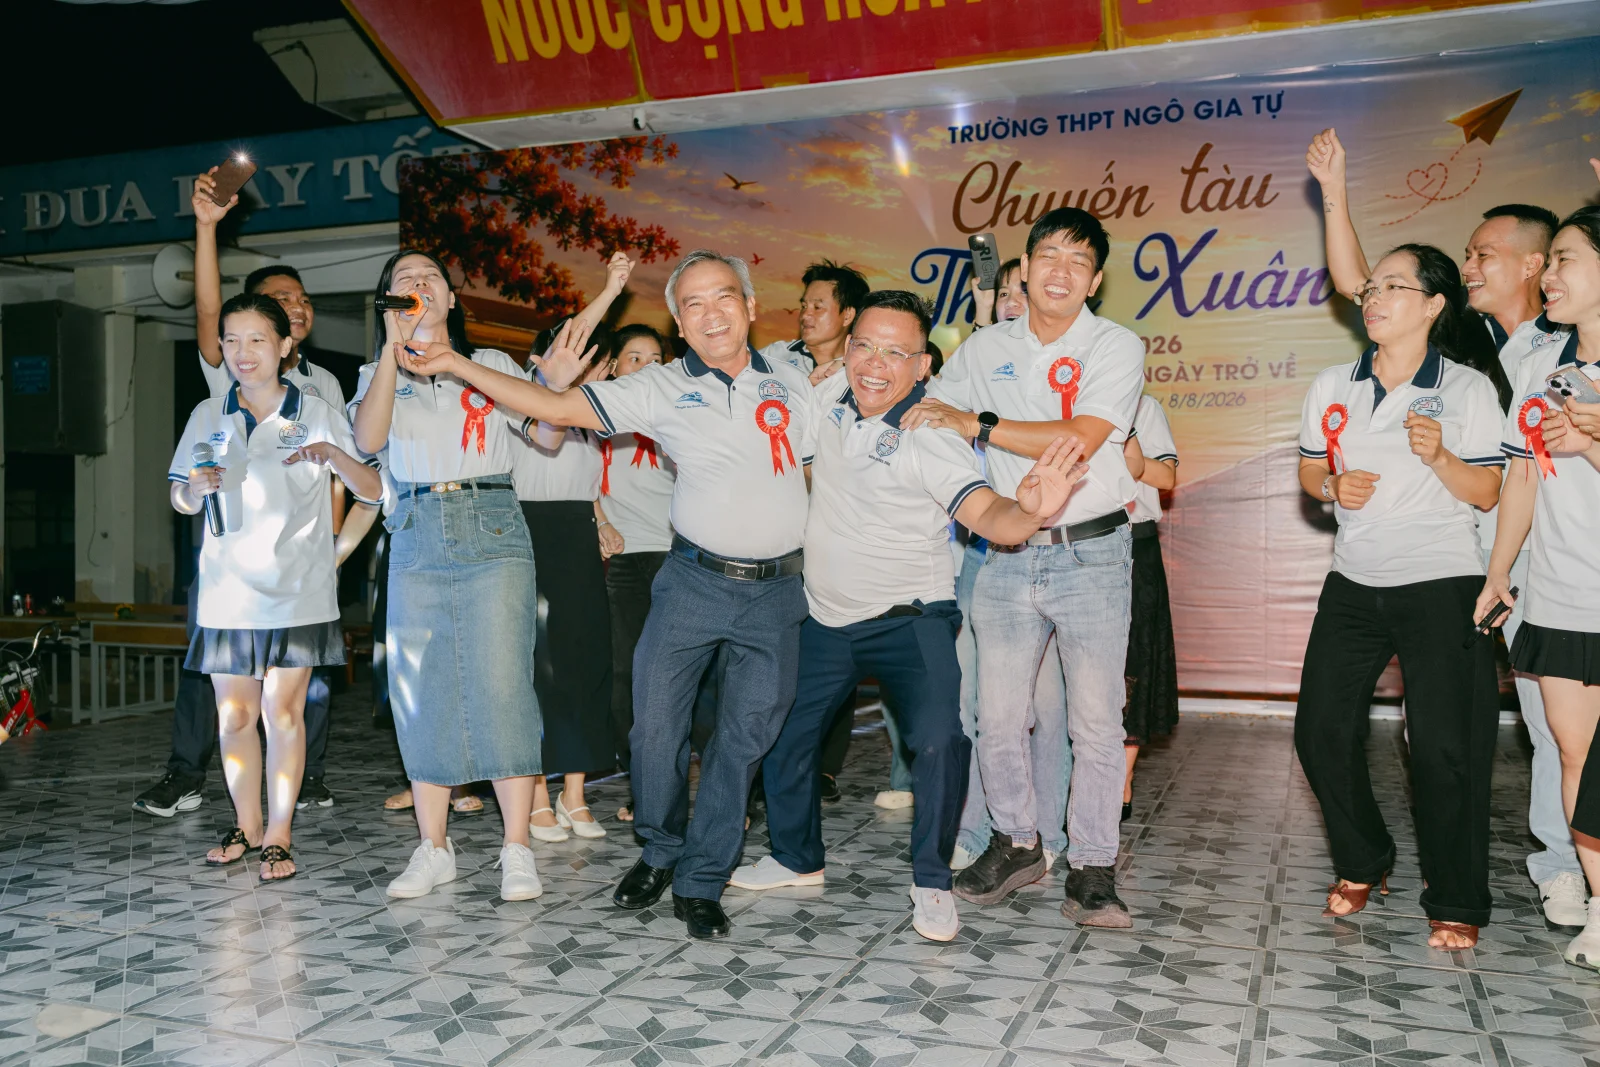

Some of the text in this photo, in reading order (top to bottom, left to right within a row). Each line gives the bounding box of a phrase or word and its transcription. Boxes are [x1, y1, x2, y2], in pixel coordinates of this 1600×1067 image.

[948, 90, 1285, 144] TRƯỜNG THPT NGÔ GIA TỰ
[1180, 142, 1280, 214] tàu
[21, 180, 156, 231] ĐUA
[1133, 228, 1336, 320] Xuân
[1140, 335, 1182, 354] 026
[1143, 352, 1297, 383] NGÀY TRỞ VỀ
[1168, 391, 1247, 409] 8/8/2026
